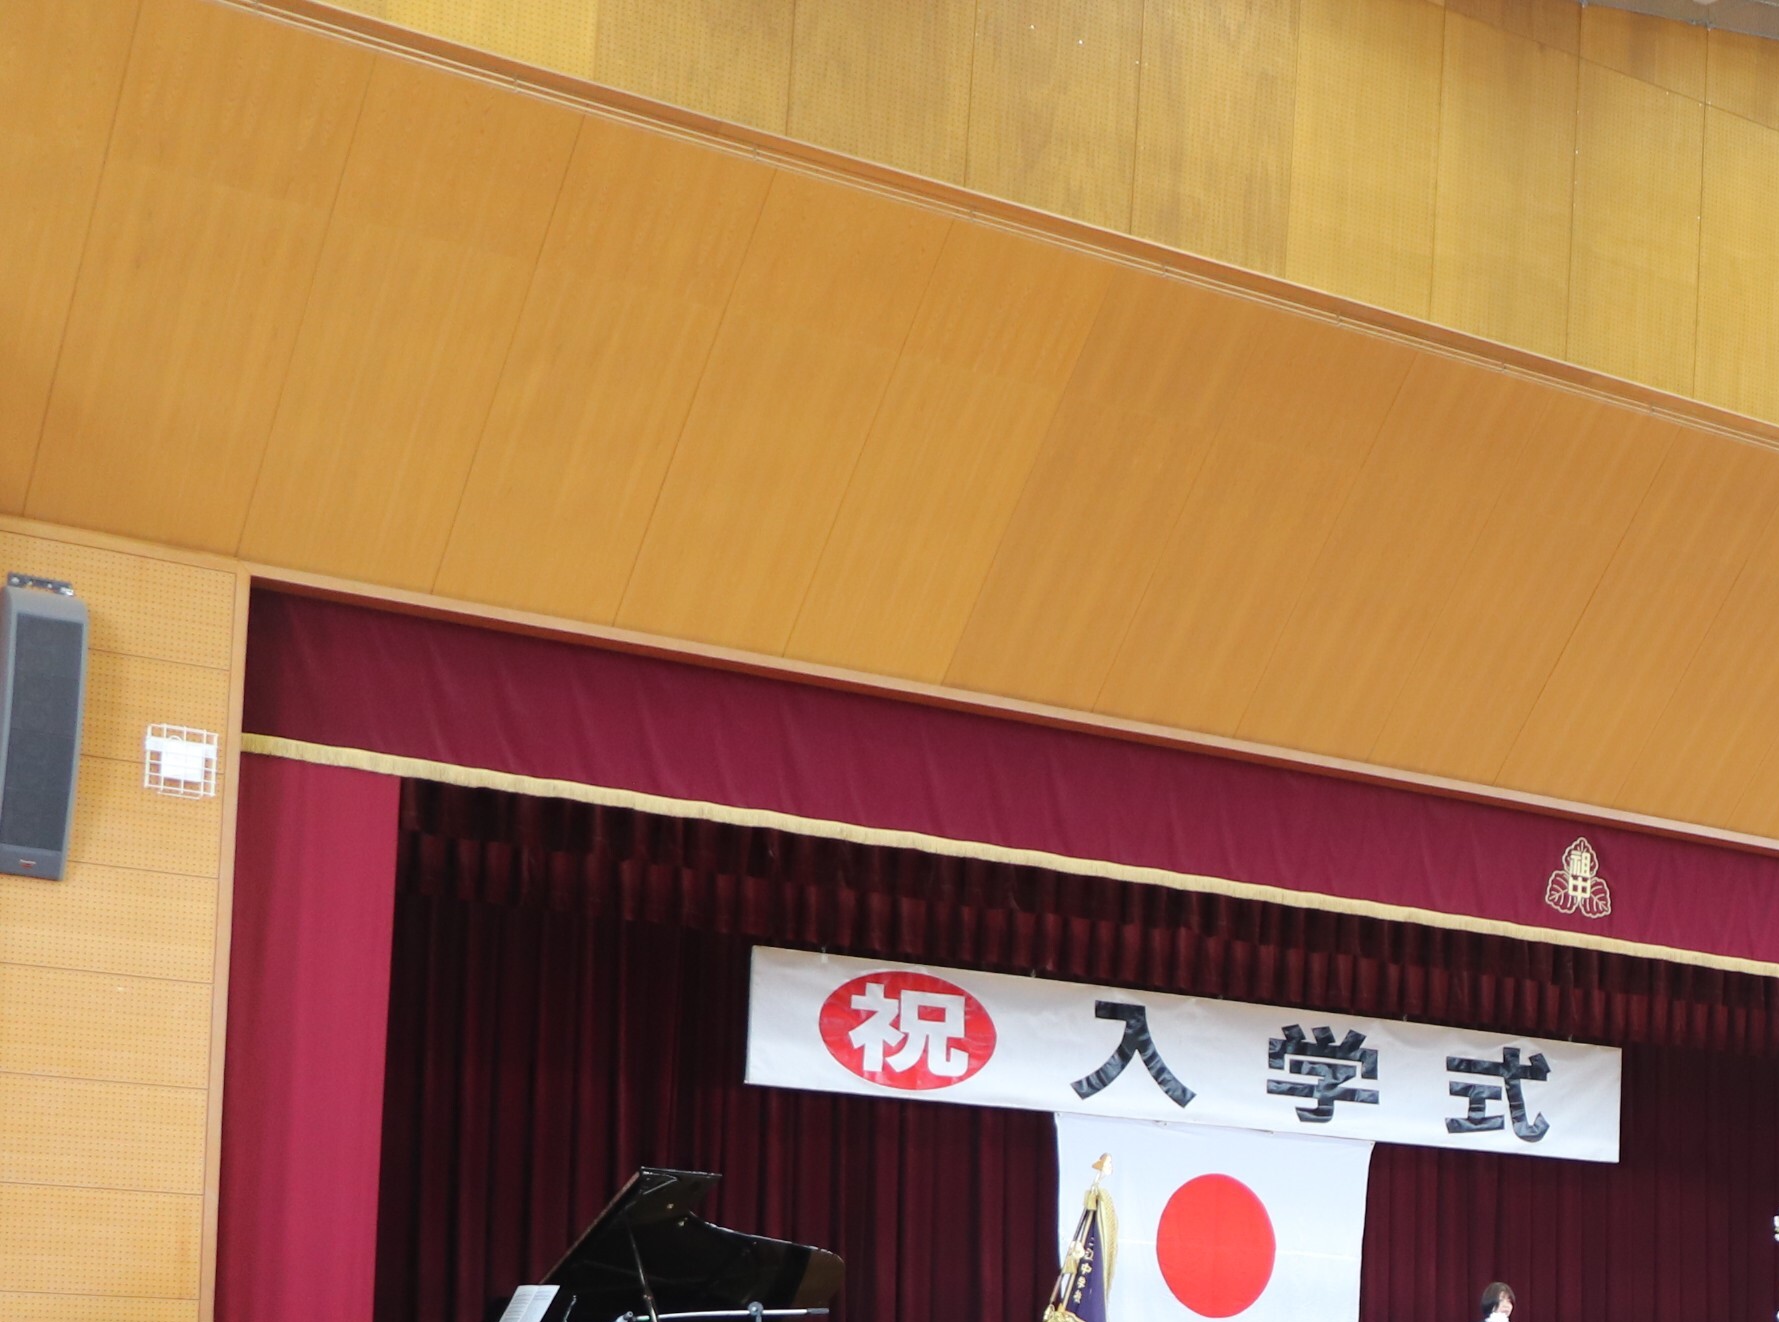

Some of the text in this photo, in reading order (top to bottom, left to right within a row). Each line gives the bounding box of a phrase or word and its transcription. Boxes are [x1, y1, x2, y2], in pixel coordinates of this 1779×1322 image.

[848, 982, 1552, 1144] 祝 入学式
